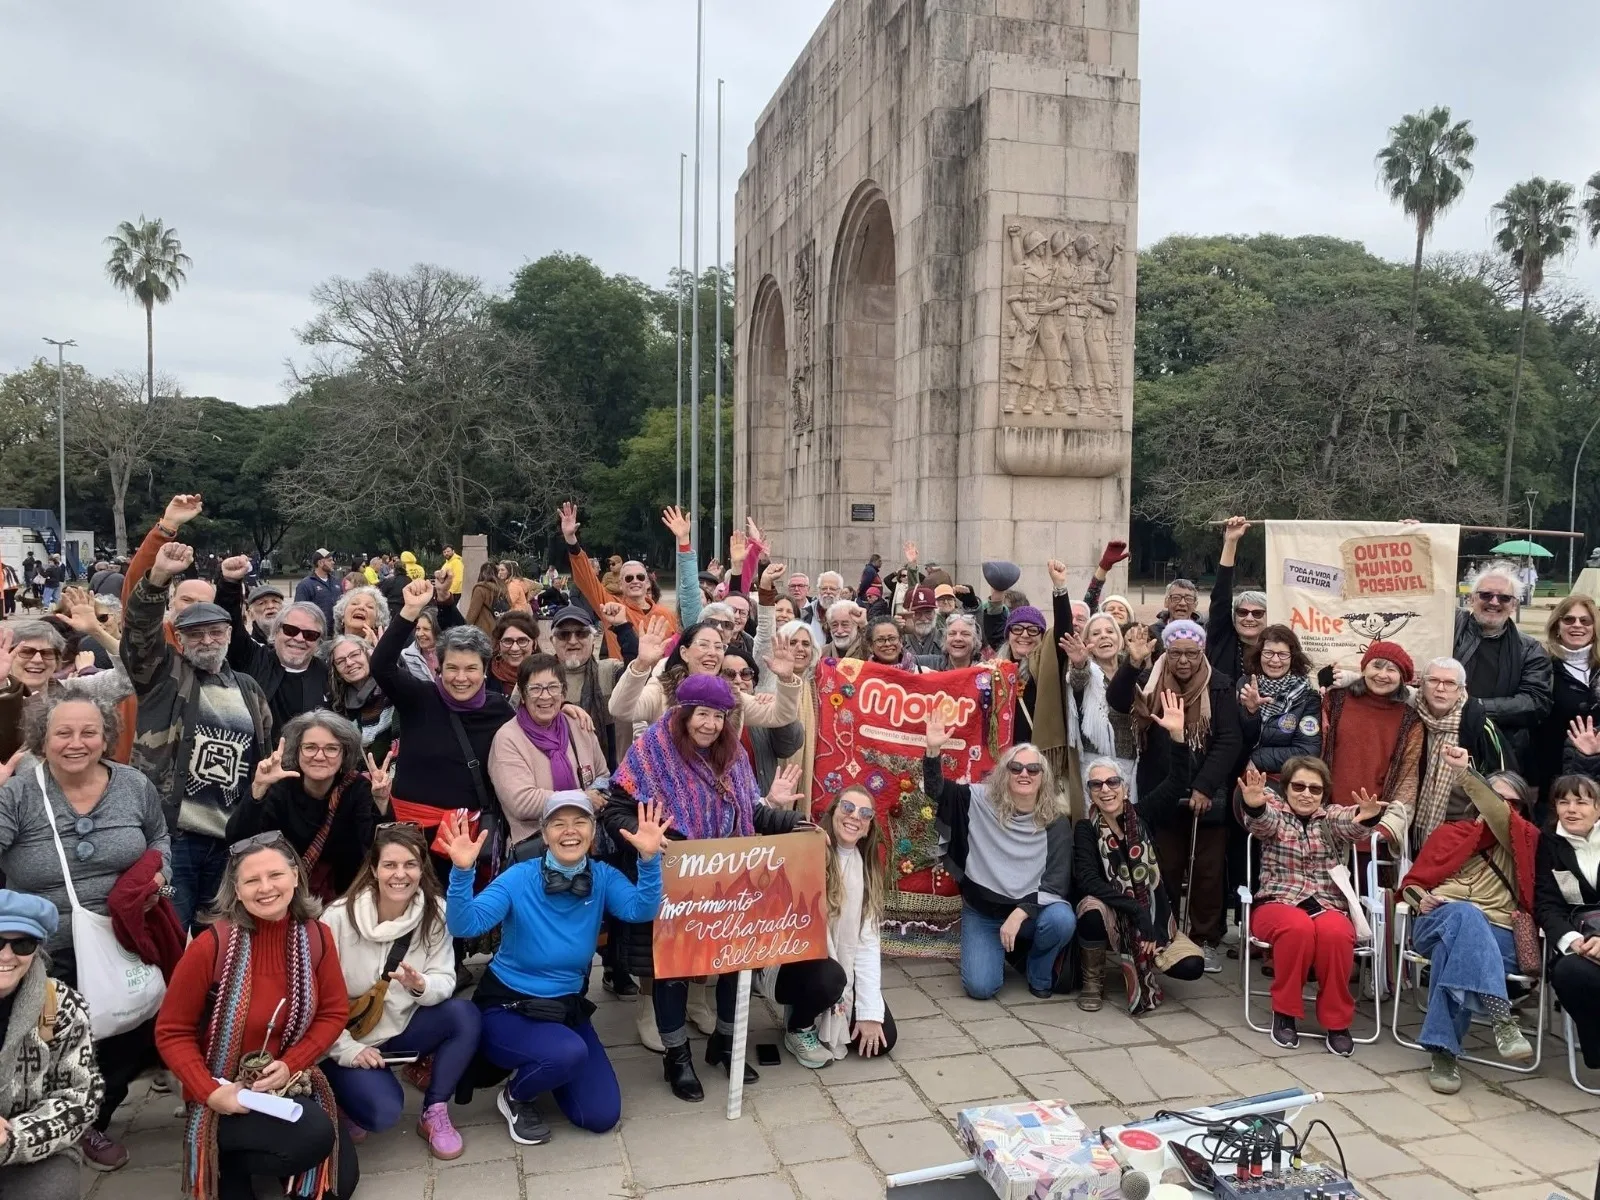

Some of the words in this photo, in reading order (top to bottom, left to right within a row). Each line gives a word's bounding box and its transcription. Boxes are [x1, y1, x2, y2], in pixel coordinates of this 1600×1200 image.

[1354, 542, 1412, 561] OUTRO
[1289, 565, 1308, 575] TODA
[1315, 571, 1331, 580] VIDA
[1332, 573, 1338, 581] É
[1354, 560, 1413, 577] MUNDO
[1296, 575, 1331, 588] CULTURA
[1359, 575, 1427, 593] POSSÍVEL
[1290, 606, 1343, 634] Alice
[685, 903, 811, 940] velharada
[712, 930, 810, 968] Rebelde
